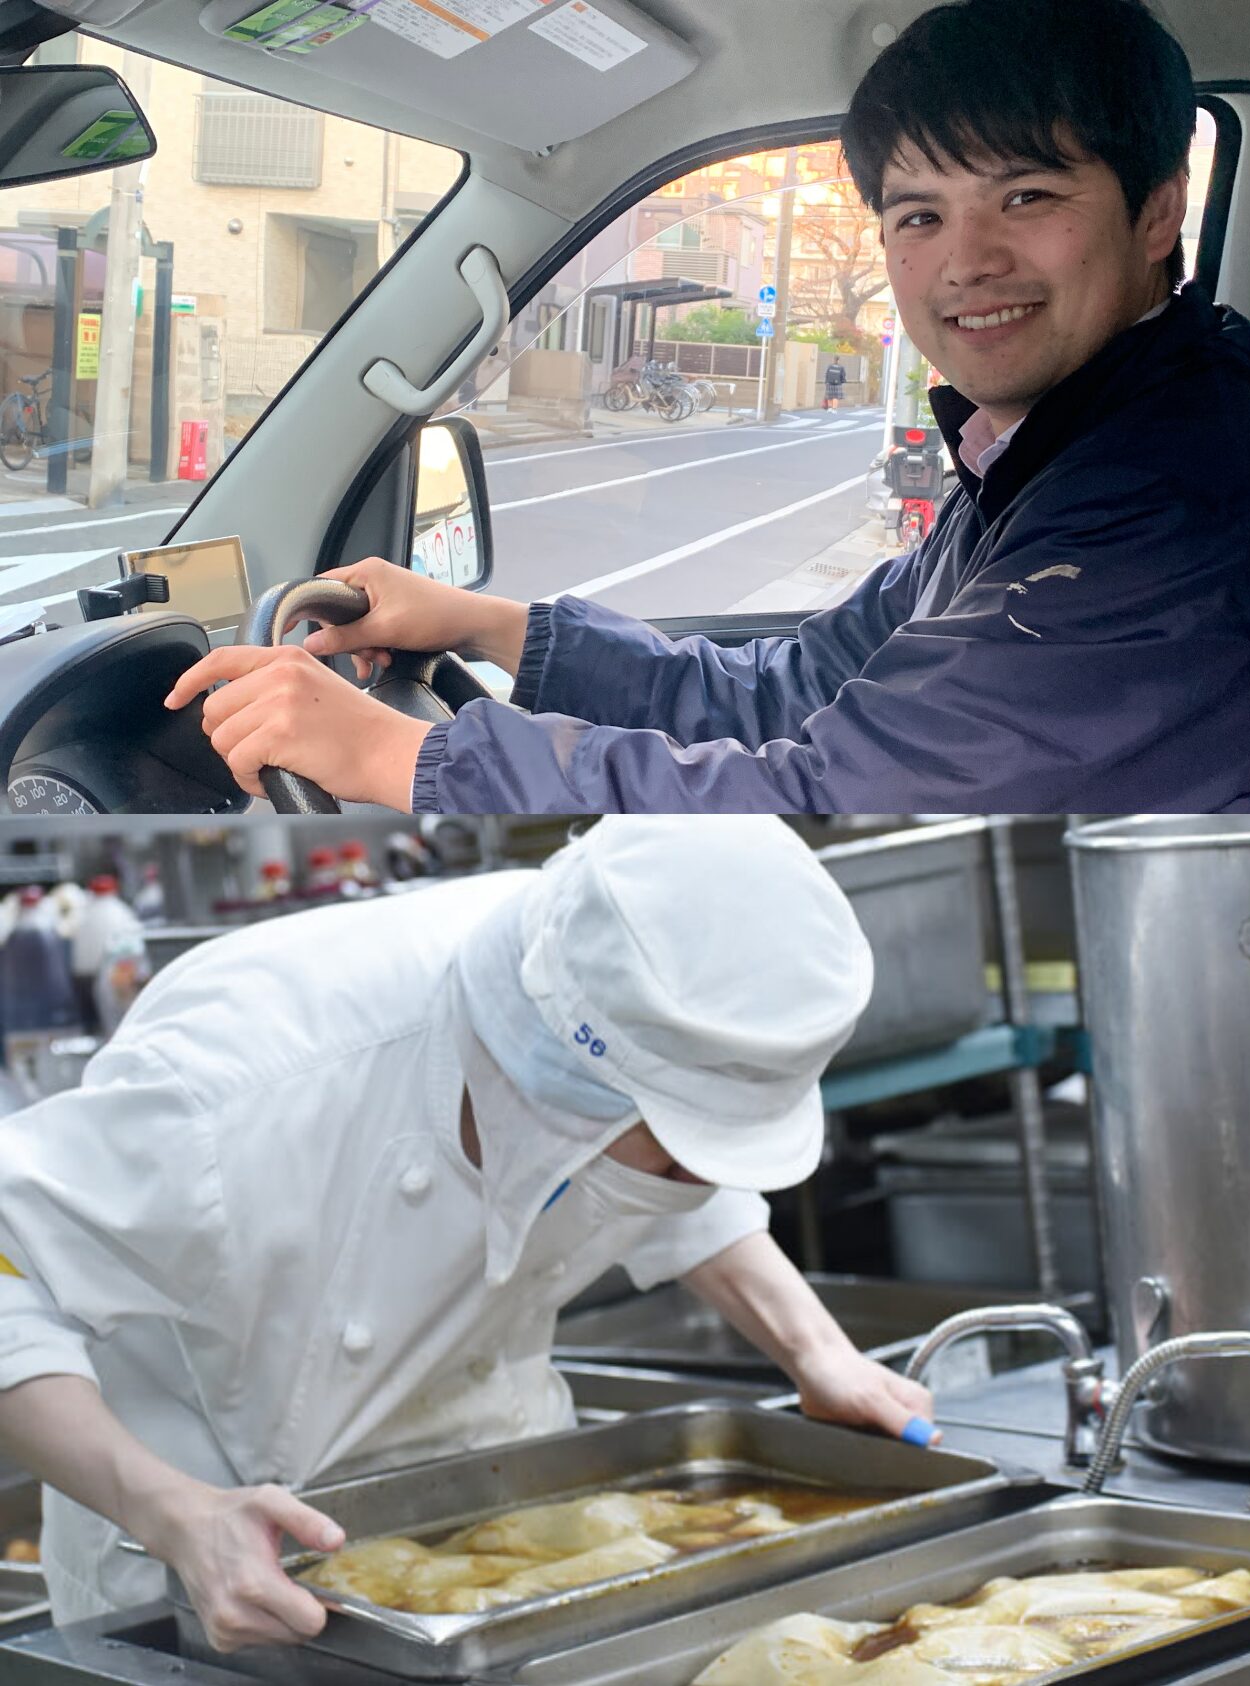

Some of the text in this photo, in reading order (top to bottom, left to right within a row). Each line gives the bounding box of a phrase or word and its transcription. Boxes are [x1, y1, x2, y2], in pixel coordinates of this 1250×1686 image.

[29, 785, 46, 800] 100
[14, 795, 28, 808] 80
[52, 793, 69, 807] 120
[574, 1022, 607, 1057] 56
